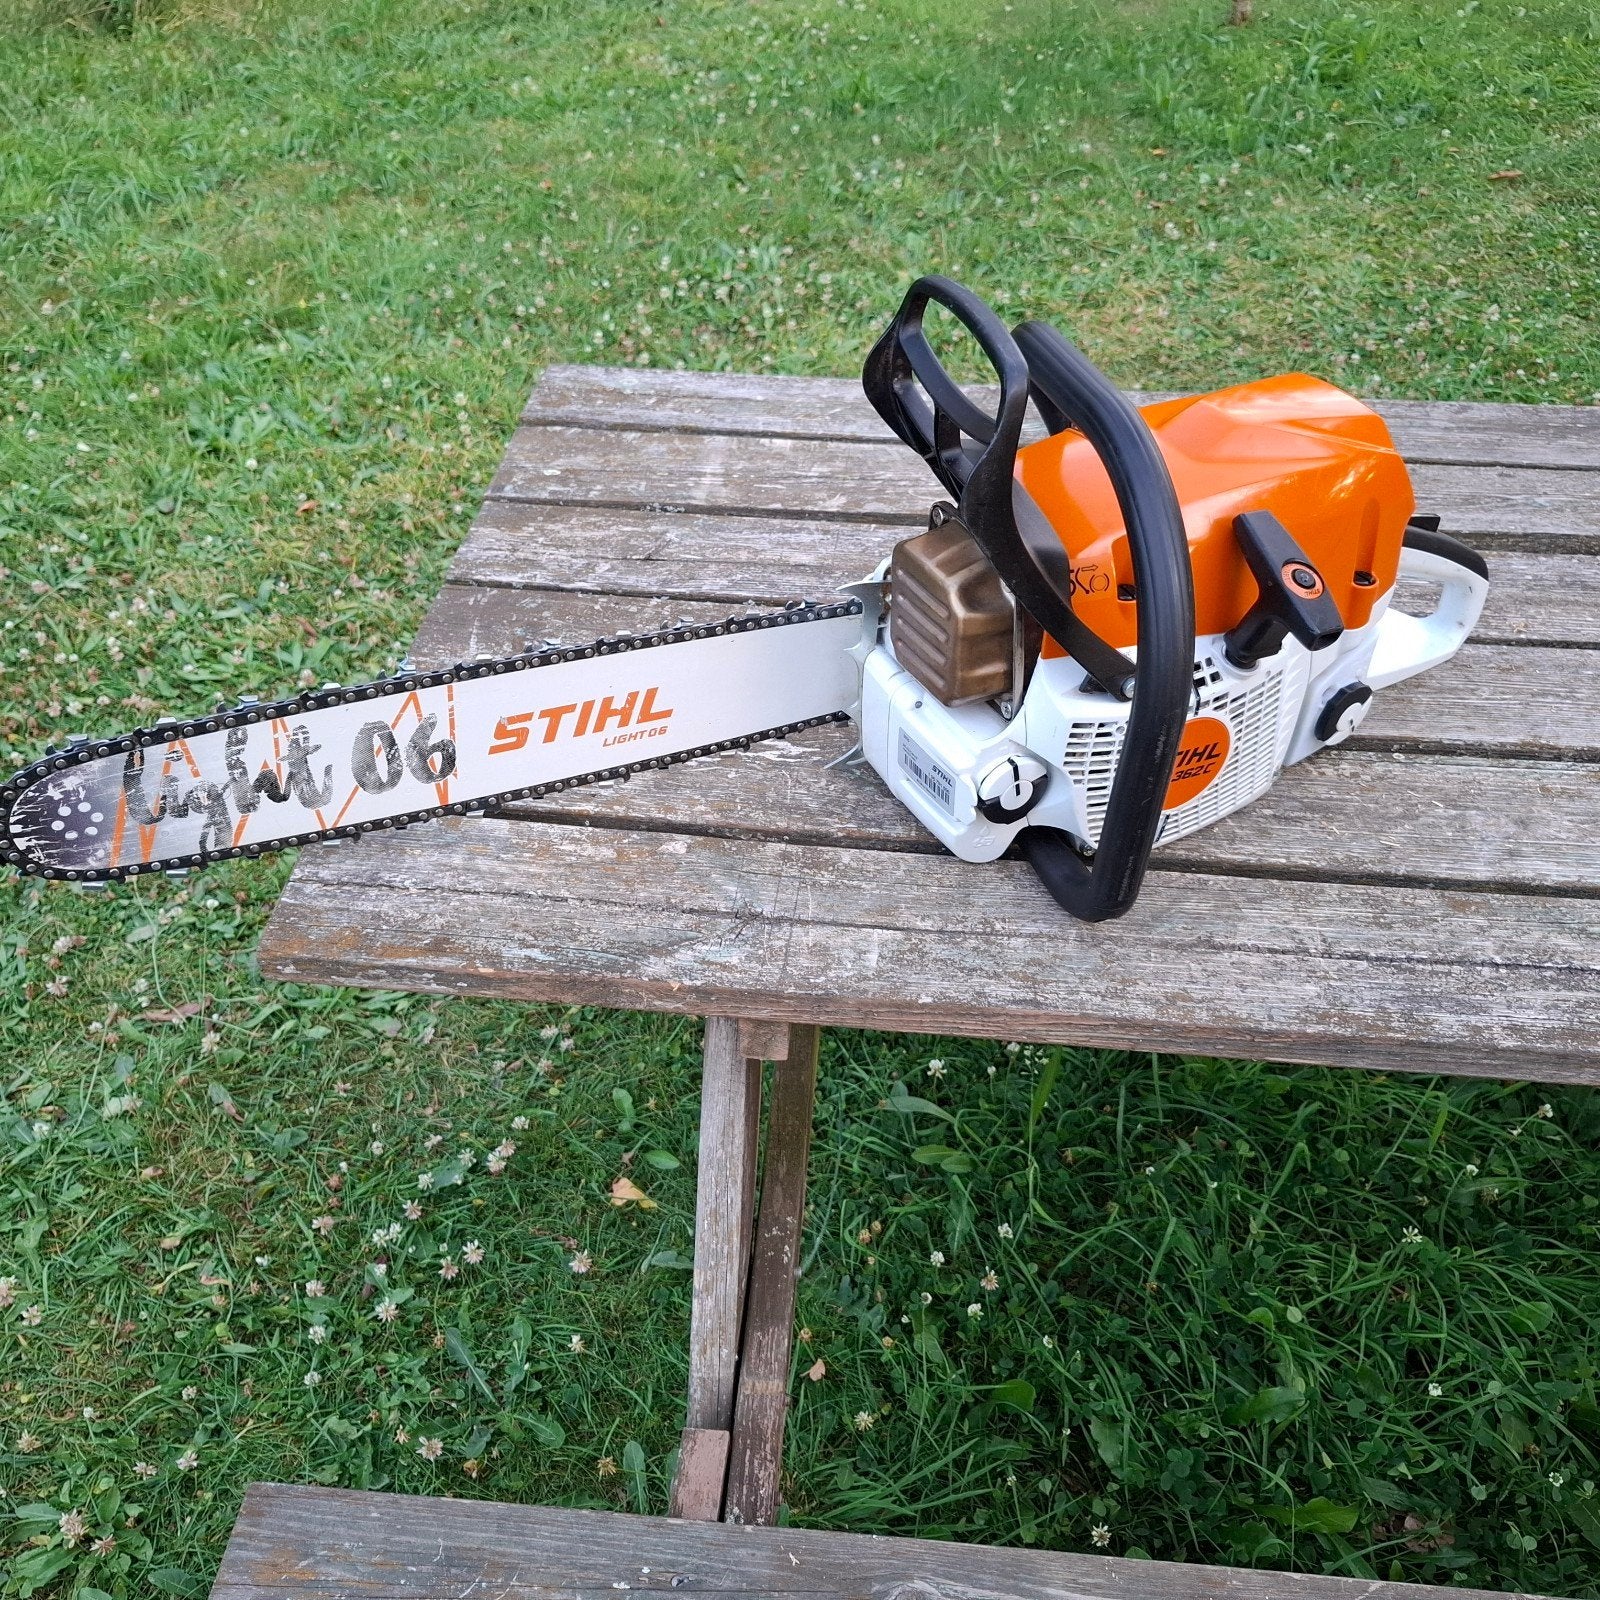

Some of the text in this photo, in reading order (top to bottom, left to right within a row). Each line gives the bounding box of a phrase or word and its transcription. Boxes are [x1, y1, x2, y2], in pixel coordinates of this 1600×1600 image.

[351, 713, 456, 795] 06
[488, 687, 674, 755] STIHL
[931, 764, 953, 788] STIHL
